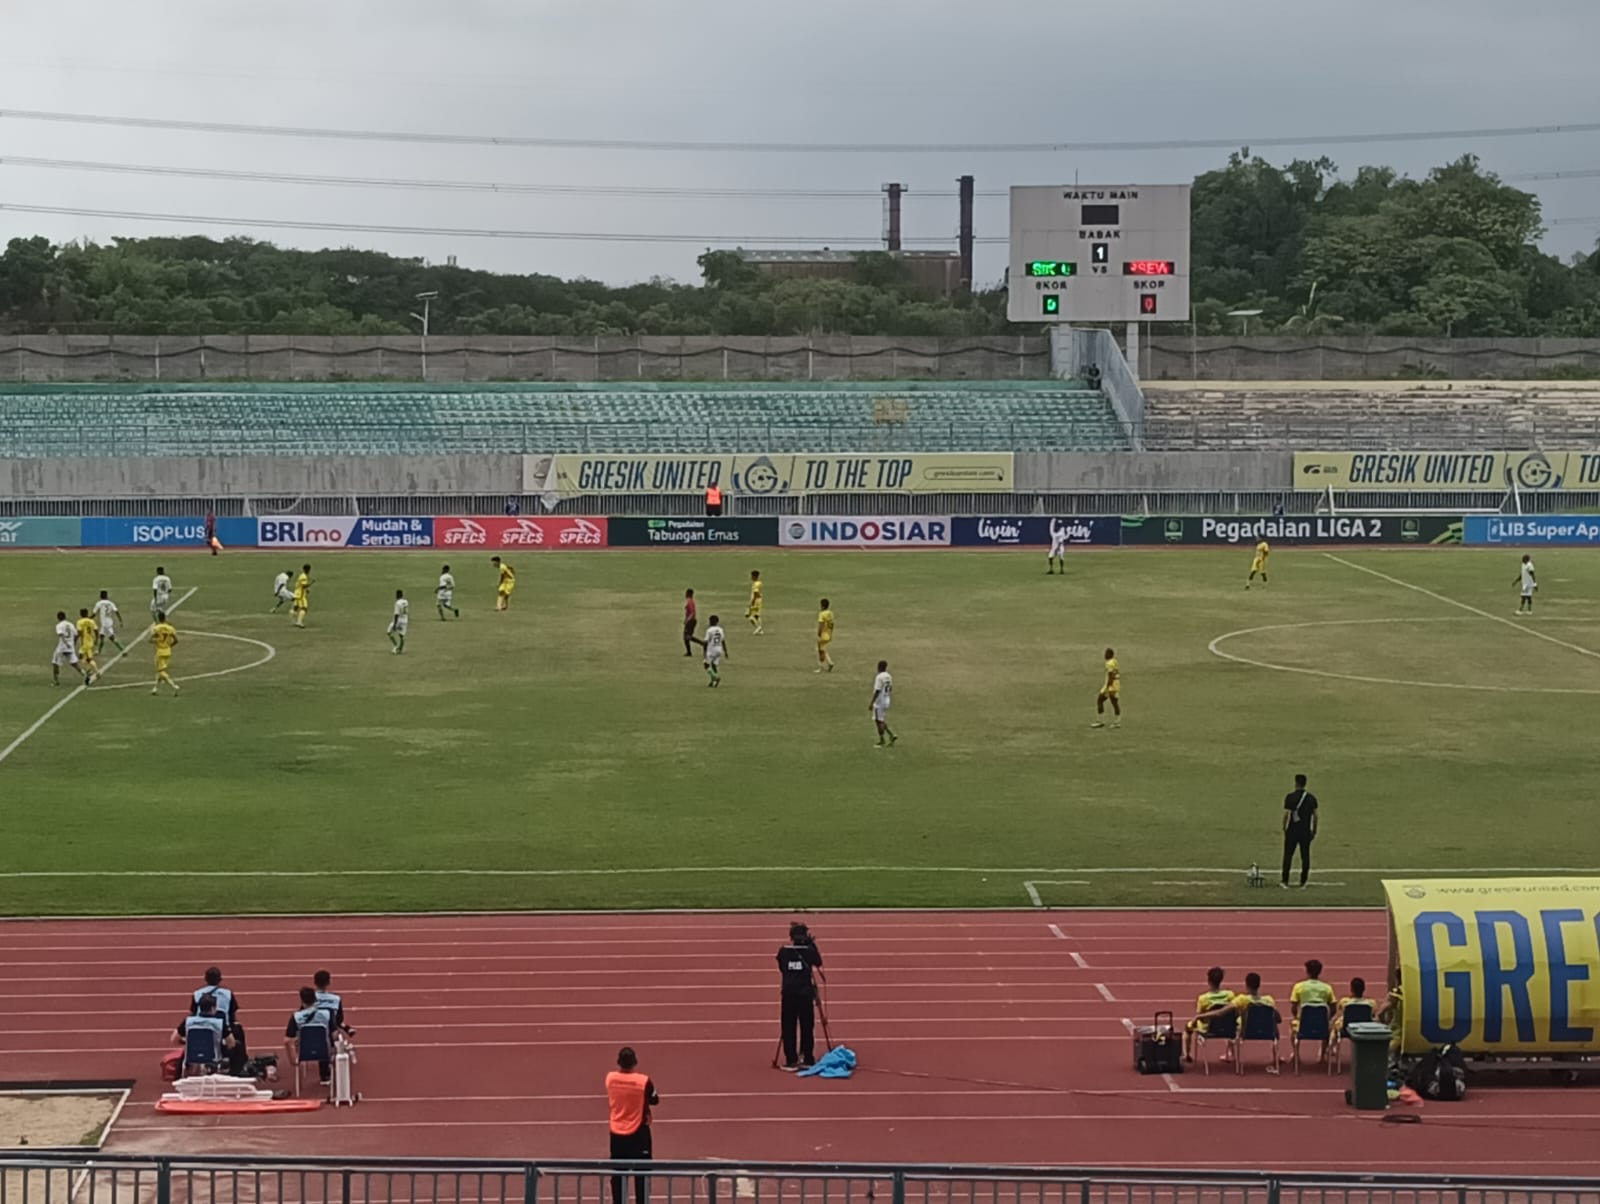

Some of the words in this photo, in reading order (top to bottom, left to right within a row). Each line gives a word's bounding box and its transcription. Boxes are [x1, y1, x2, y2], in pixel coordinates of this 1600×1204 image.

[1063, 191, 1105, 200] WAKTU
[1110, 191, 1138, 200] MAIN
[1079, 230, 1121, 239] BABAK
[1096, 246, 1104, 260] 1
[1092, 265, 1107, 274] VS
[1036, 281, 1068, 289] SKOR
[1133, 280, 1165, 289] SKOR
[1144, 297, 1153, 312] 0
[578, 460, 649, 490] GRESIK
[652, 460, 722, 489] UNITED
[805, 459, 829, 489] TO
[835, 459, 871, 489] THE
[877, 459, 913, 488] TOP
[1349, 454, 1420, 483] GRESIK
[1424, 454, 1495, 483] UNITED
[1579, 454, 1600, 483] TO
[261, 522, 342, 542] BRImo
[361, 519, 408, 531] Mudah
[411, 519, 423, 531] &
[811, 521, 946, 541] INDOSIAR
[1202, 518, 1310, 542] Pegadaian
[1316, 518, 1366, 537] LIGA
[1369, 519, 1382, 537] 2
[1527, 522, 1575, 540] Super
[133, 525, 206, 542] ISOPLUS
[361, 534, 400, 545] Serba
[403, 534, 431, 545] Bisa
[444, 532, 487, 544] SPECS
[502, 532, 544, 544] SPECS
[559, 532, 601, 544] SPECS
[647, 528, 705, 543] Tabungan
[708, 528, 740, 541] Emas
[1413, 908, 1600, 1044] GRE
